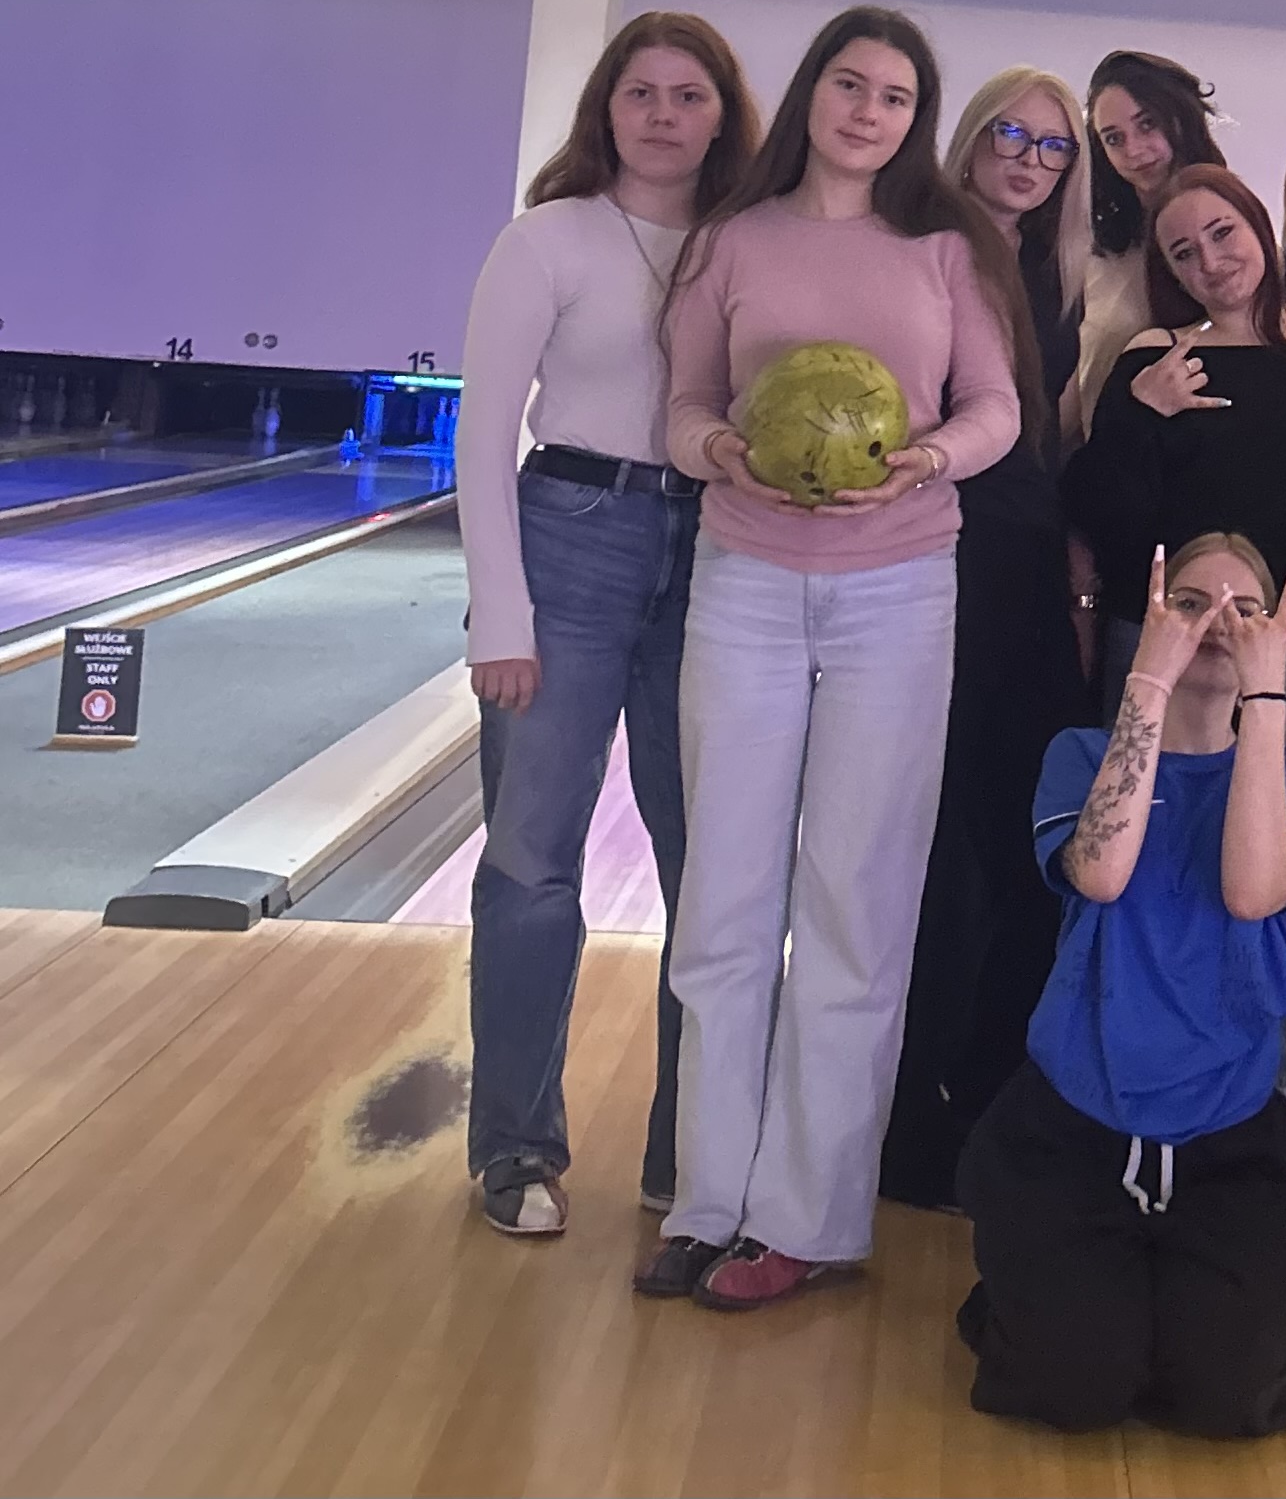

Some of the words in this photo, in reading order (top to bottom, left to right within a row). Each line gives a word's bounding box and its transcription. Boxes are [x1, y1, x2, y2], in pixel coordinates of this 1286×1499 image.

[166, 336, 194, 362] 14
[407, 350, 436, 373] 15
[85, 662, 120, 674] STAFF
[87, 674, 119, 686] ONLY
